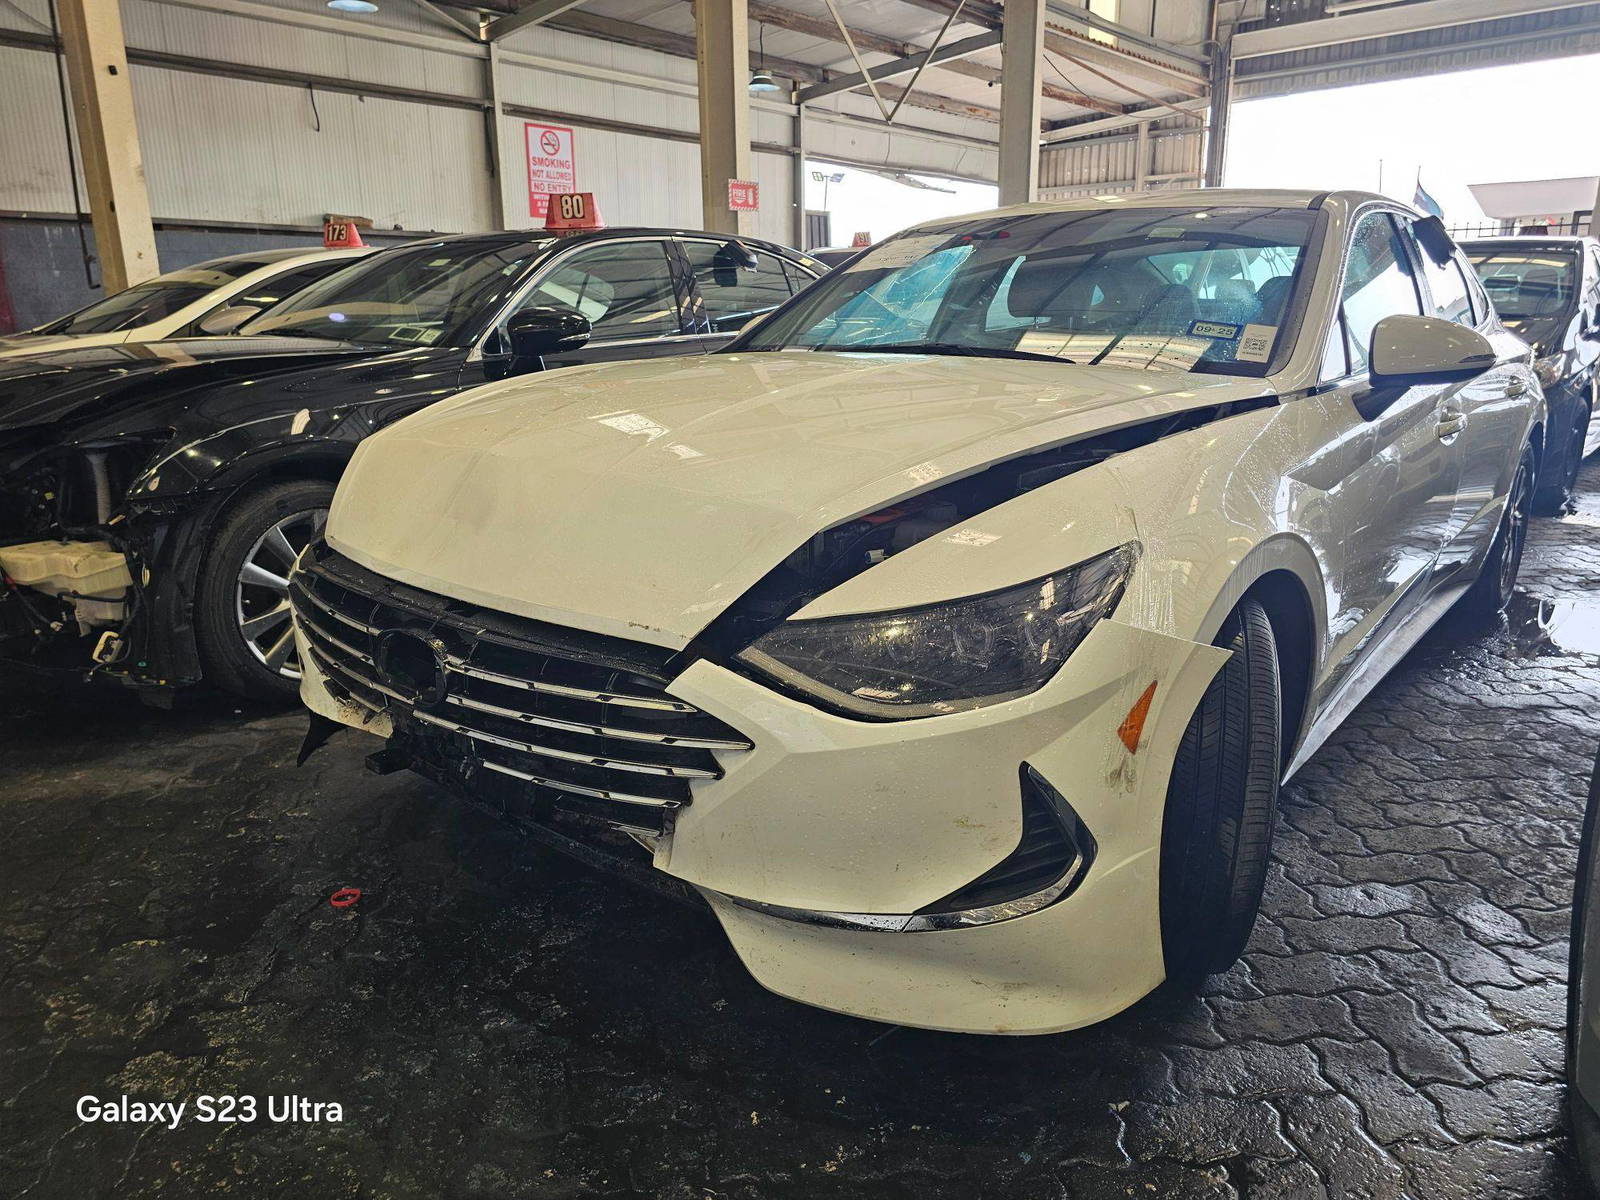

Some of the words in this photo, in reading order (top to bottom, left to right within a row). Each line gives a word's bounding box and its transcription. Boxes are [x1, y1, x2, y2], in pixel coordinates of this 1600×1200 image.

[532, 157, 570, 169] SMOKING
[532, 169, 545, 178] NOT
[546, 171, 571, 181] ALLOWED
[534, 182, 545, 191] NO
[548, 184, 571, 192] ENTRY
[561, 195, 584, 218] 80
[328, 223, 347, 241] 173
